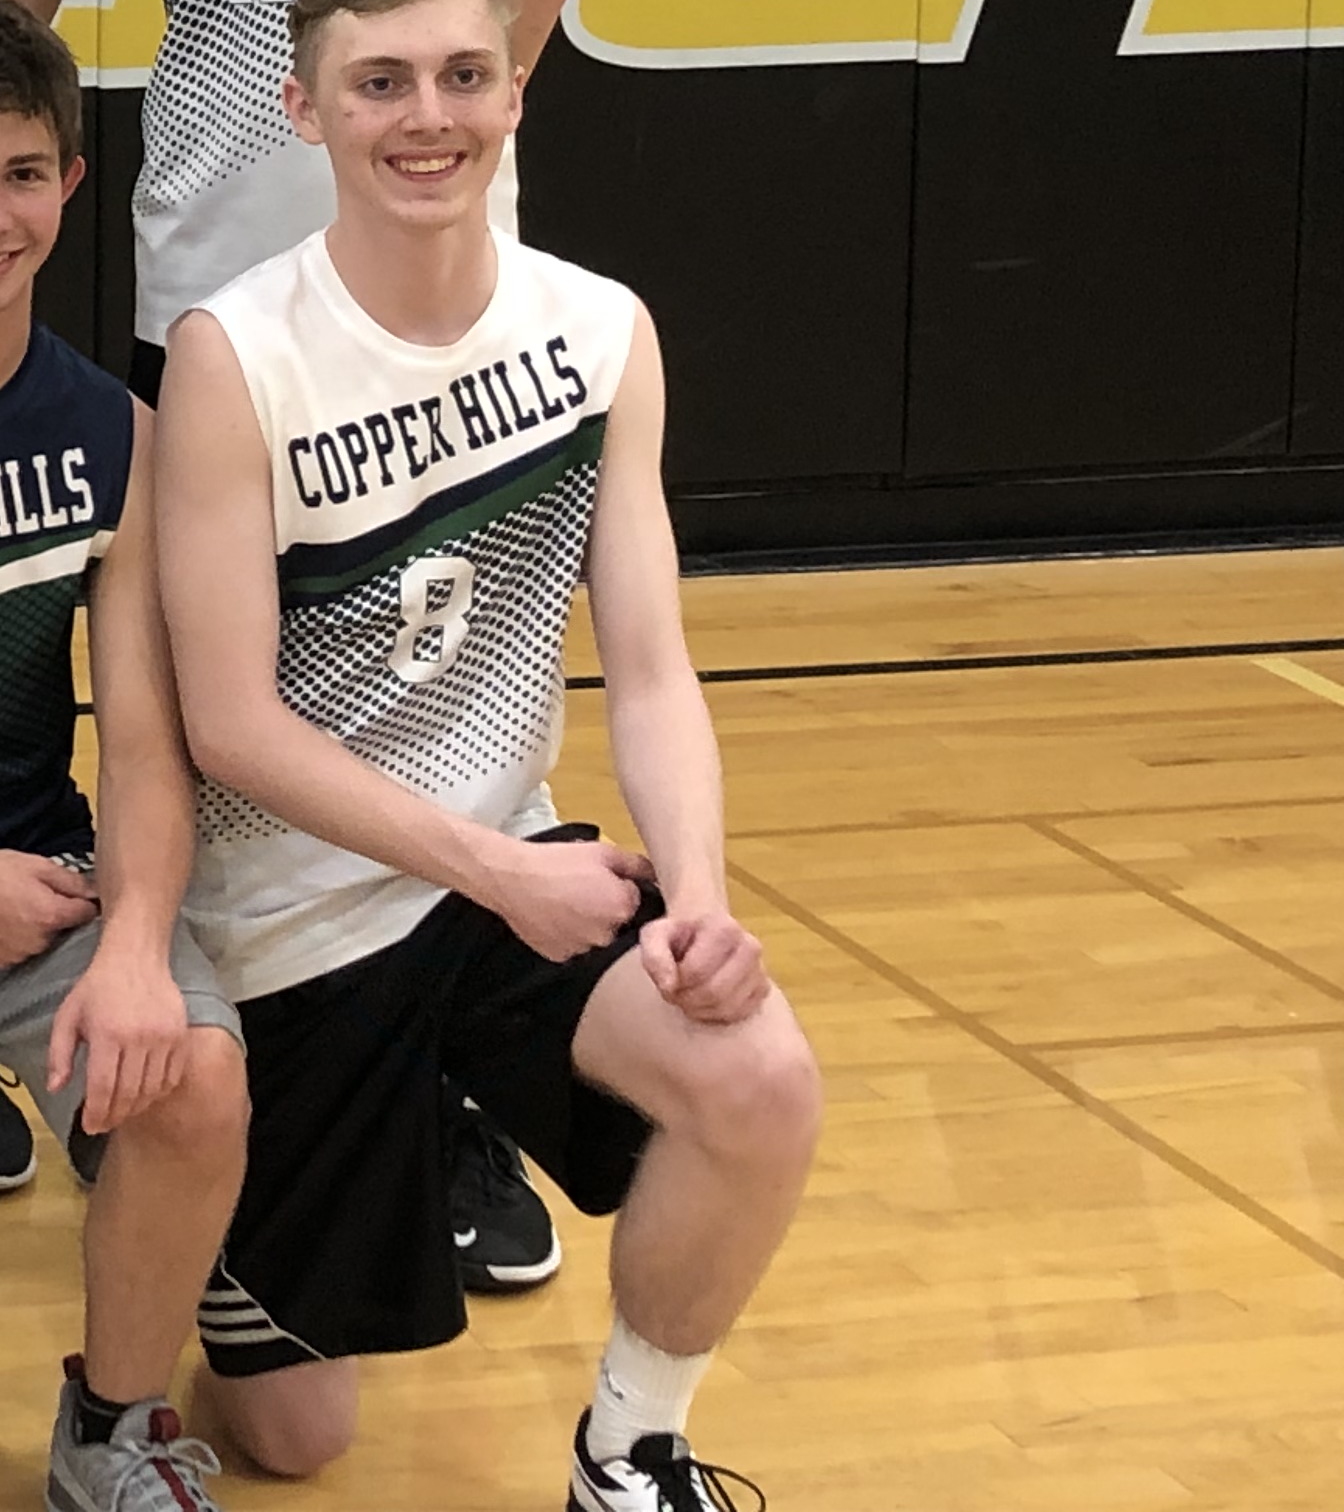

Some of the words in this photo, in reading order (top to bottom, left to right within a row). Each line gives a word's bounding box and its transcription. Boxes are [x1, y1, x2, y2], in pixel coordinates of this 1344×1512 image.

[288, 395, 456, 509] COPPER
[449, 335, 588, 451] HILLS
[386, 555, 478, 684] 8
